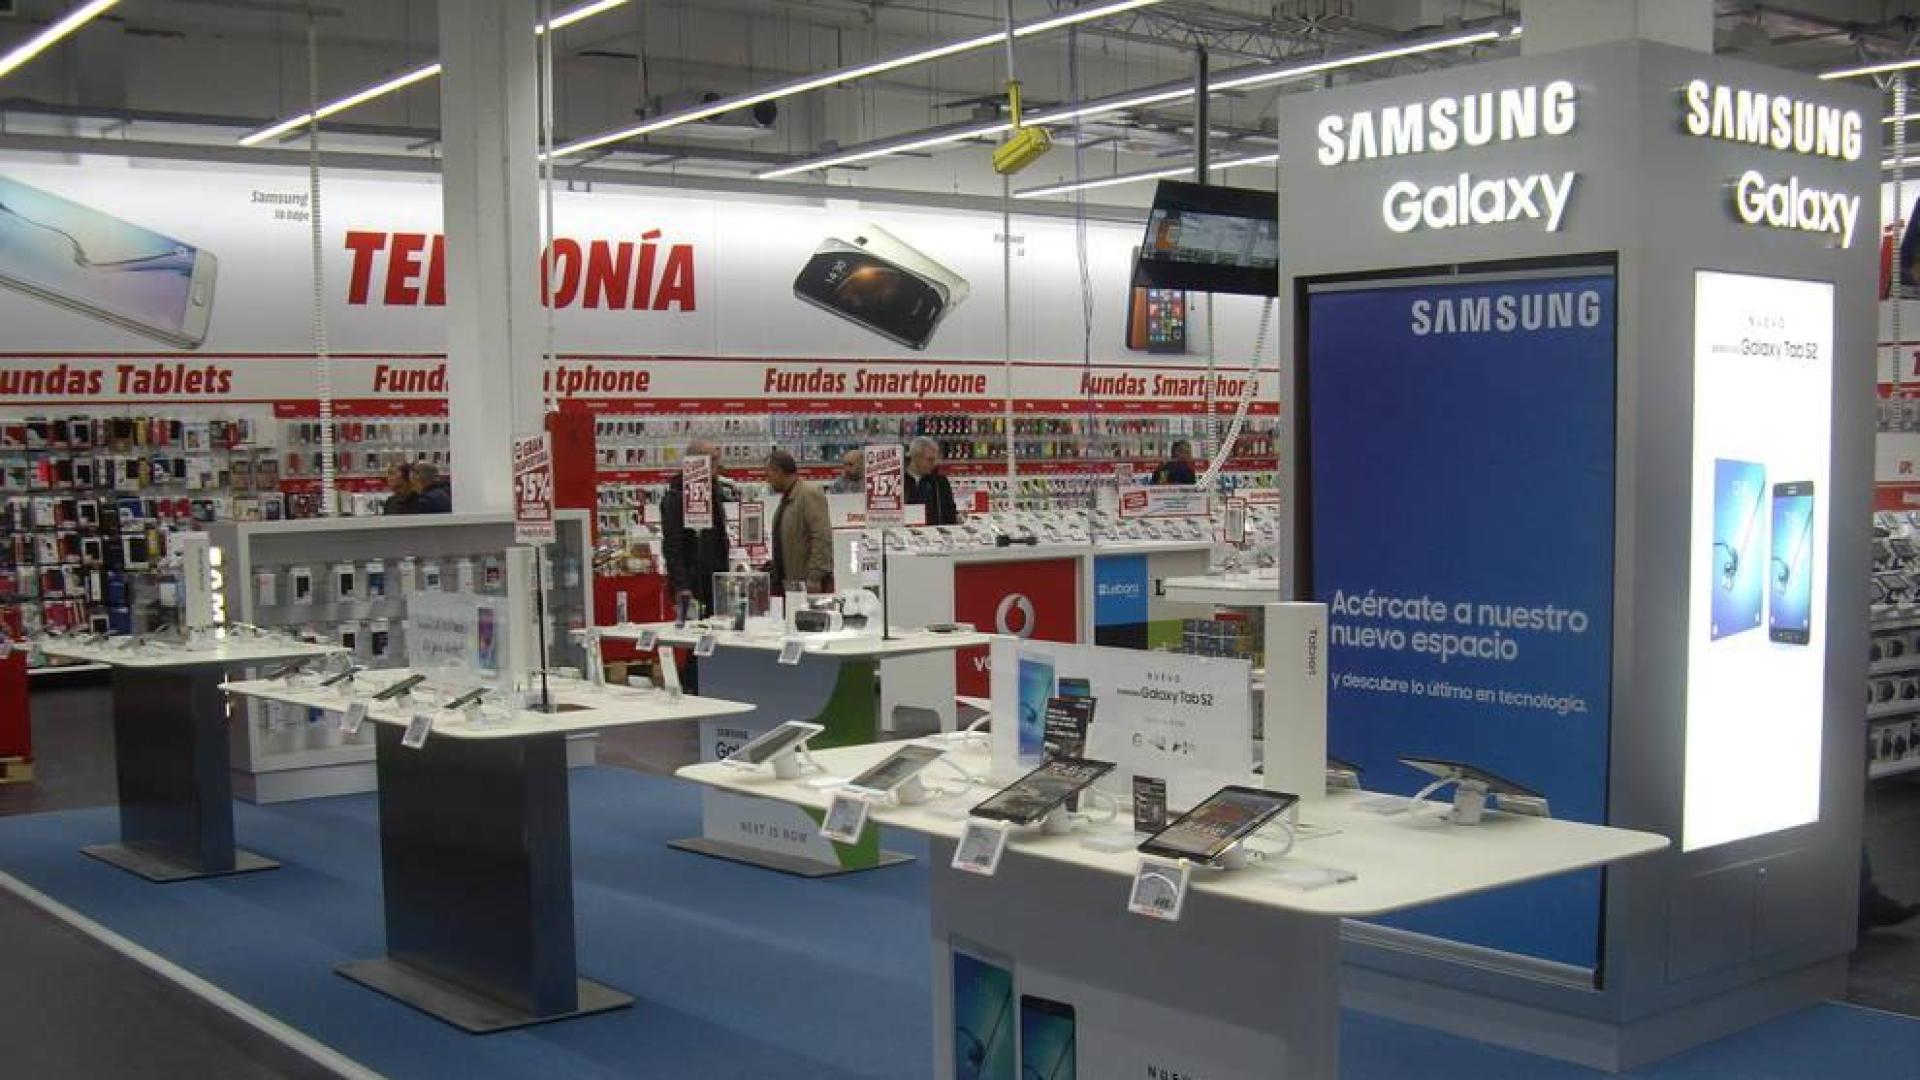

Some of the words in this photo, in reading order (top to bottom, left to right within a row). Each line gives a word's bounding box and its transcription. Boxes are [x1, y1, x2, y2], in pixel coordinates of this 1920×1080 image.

[1318, 80, 1576, 167] SAMSUNG
[1687, 79, 1863, 160] SAMSUNG
[1383, 171, 1576, 233] Galaxy
[1736, 170, 1860, 249] Galaxy
[1411, 290, 1601, 336] SAMSUNG
[0, 364, 103, 394] undas
[116, 364, 233, 394] Tablets
[373, 365, 448, 392] Fund
[764, 367, 846, 393] Fundas
[854, 368, 987, 396] Smartphone
[1080, 372, 1146, 394] Fundas
[1152, 373, 1259, 401] Smartho
[1331, 588, 1448, 622] Acércate
[1454, 603, 1472, 624] a
[1477, 604, 1589, 633] nuestro
[1330, 623, 1404, 650] nuevo
[1411, 630, 1519, 663] espacio
[1140, 686, 1179, 705] Galaxy
[1331, 672, 1341, 689] y
[1342, 671, 1409, 694] descubre
[1411, 679, 1424, 696] lo
[1427, 680, 1473, 701] último
[1475, 690, 1496, 702] en
